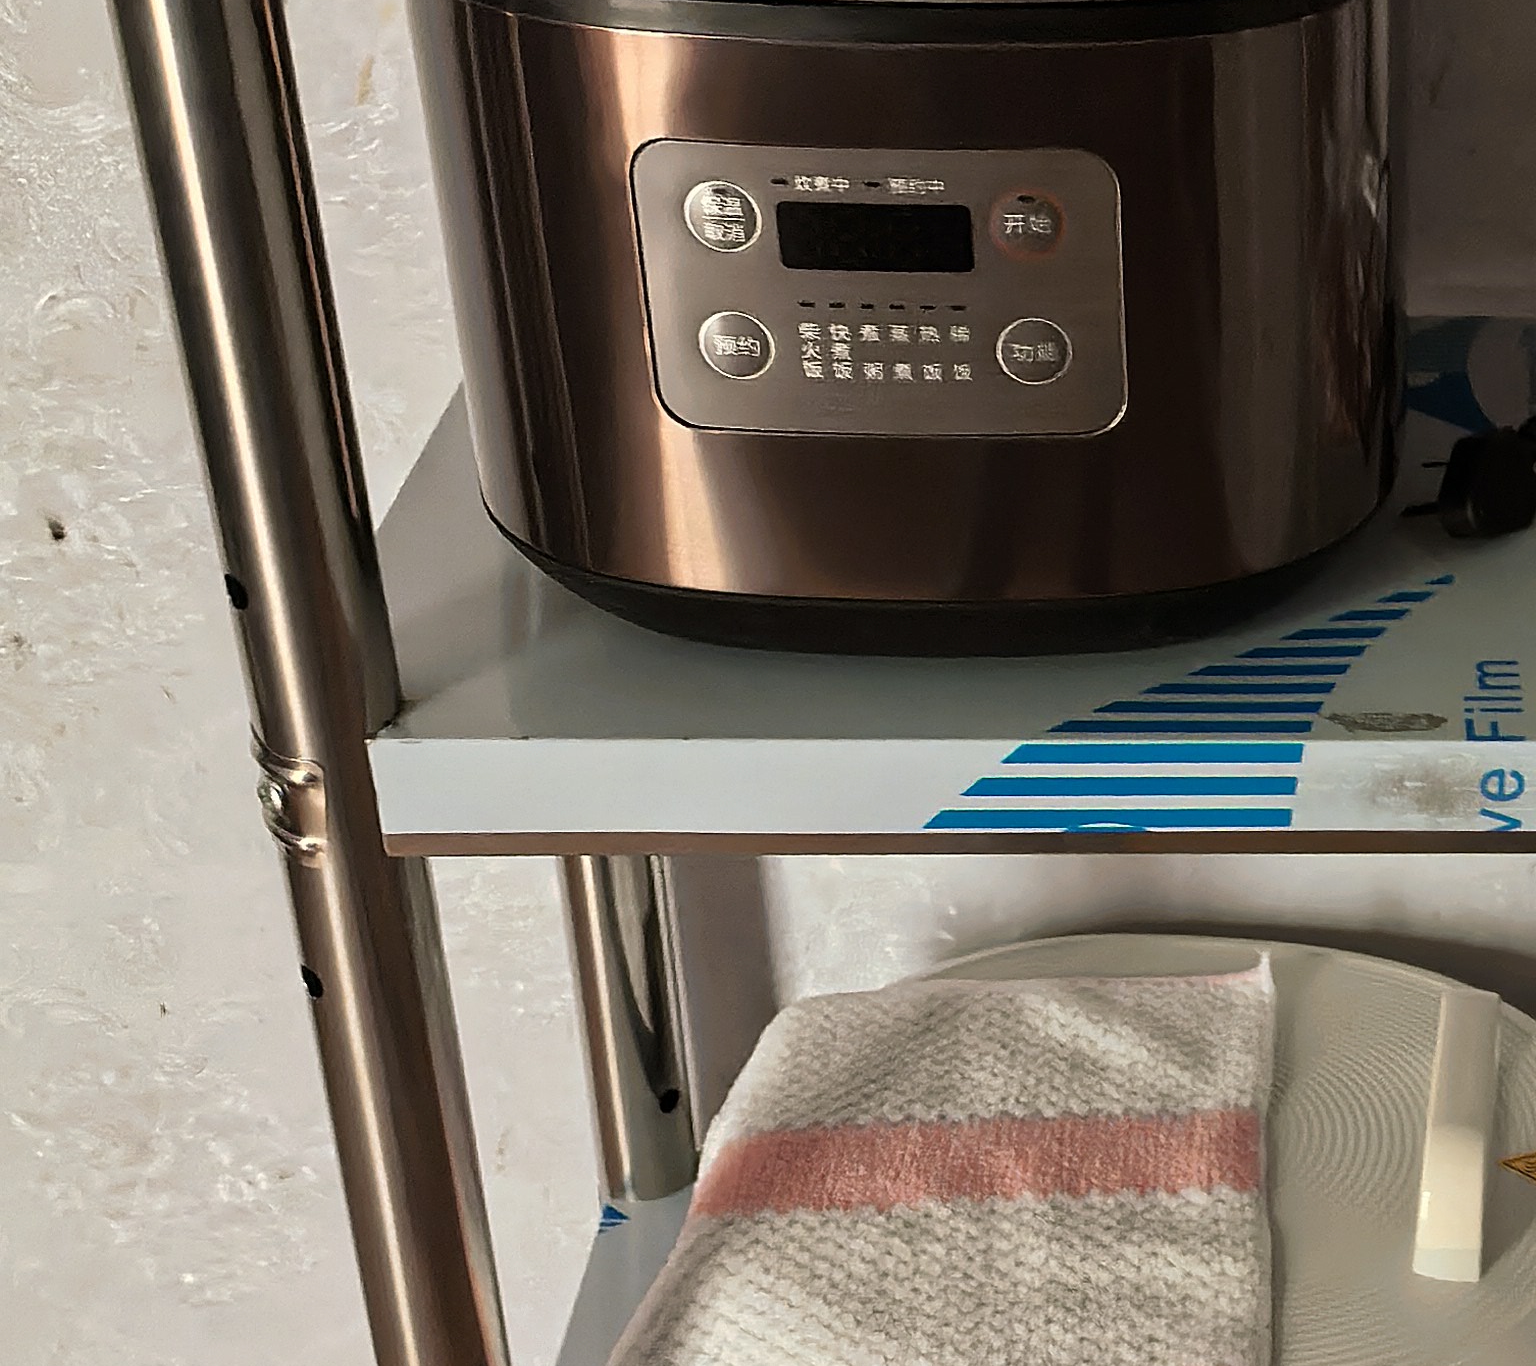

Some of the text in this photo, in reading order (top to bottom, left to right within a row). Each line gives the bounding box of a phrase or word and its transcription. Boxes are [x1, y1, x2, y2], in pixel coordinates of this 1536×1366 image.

[1002, 213, 1053, 235] 开始
[712, 333, 761, 357] 预约
[1010, 341, 1057, 364] 功能
[1464, 659, 1526, 741] Film
